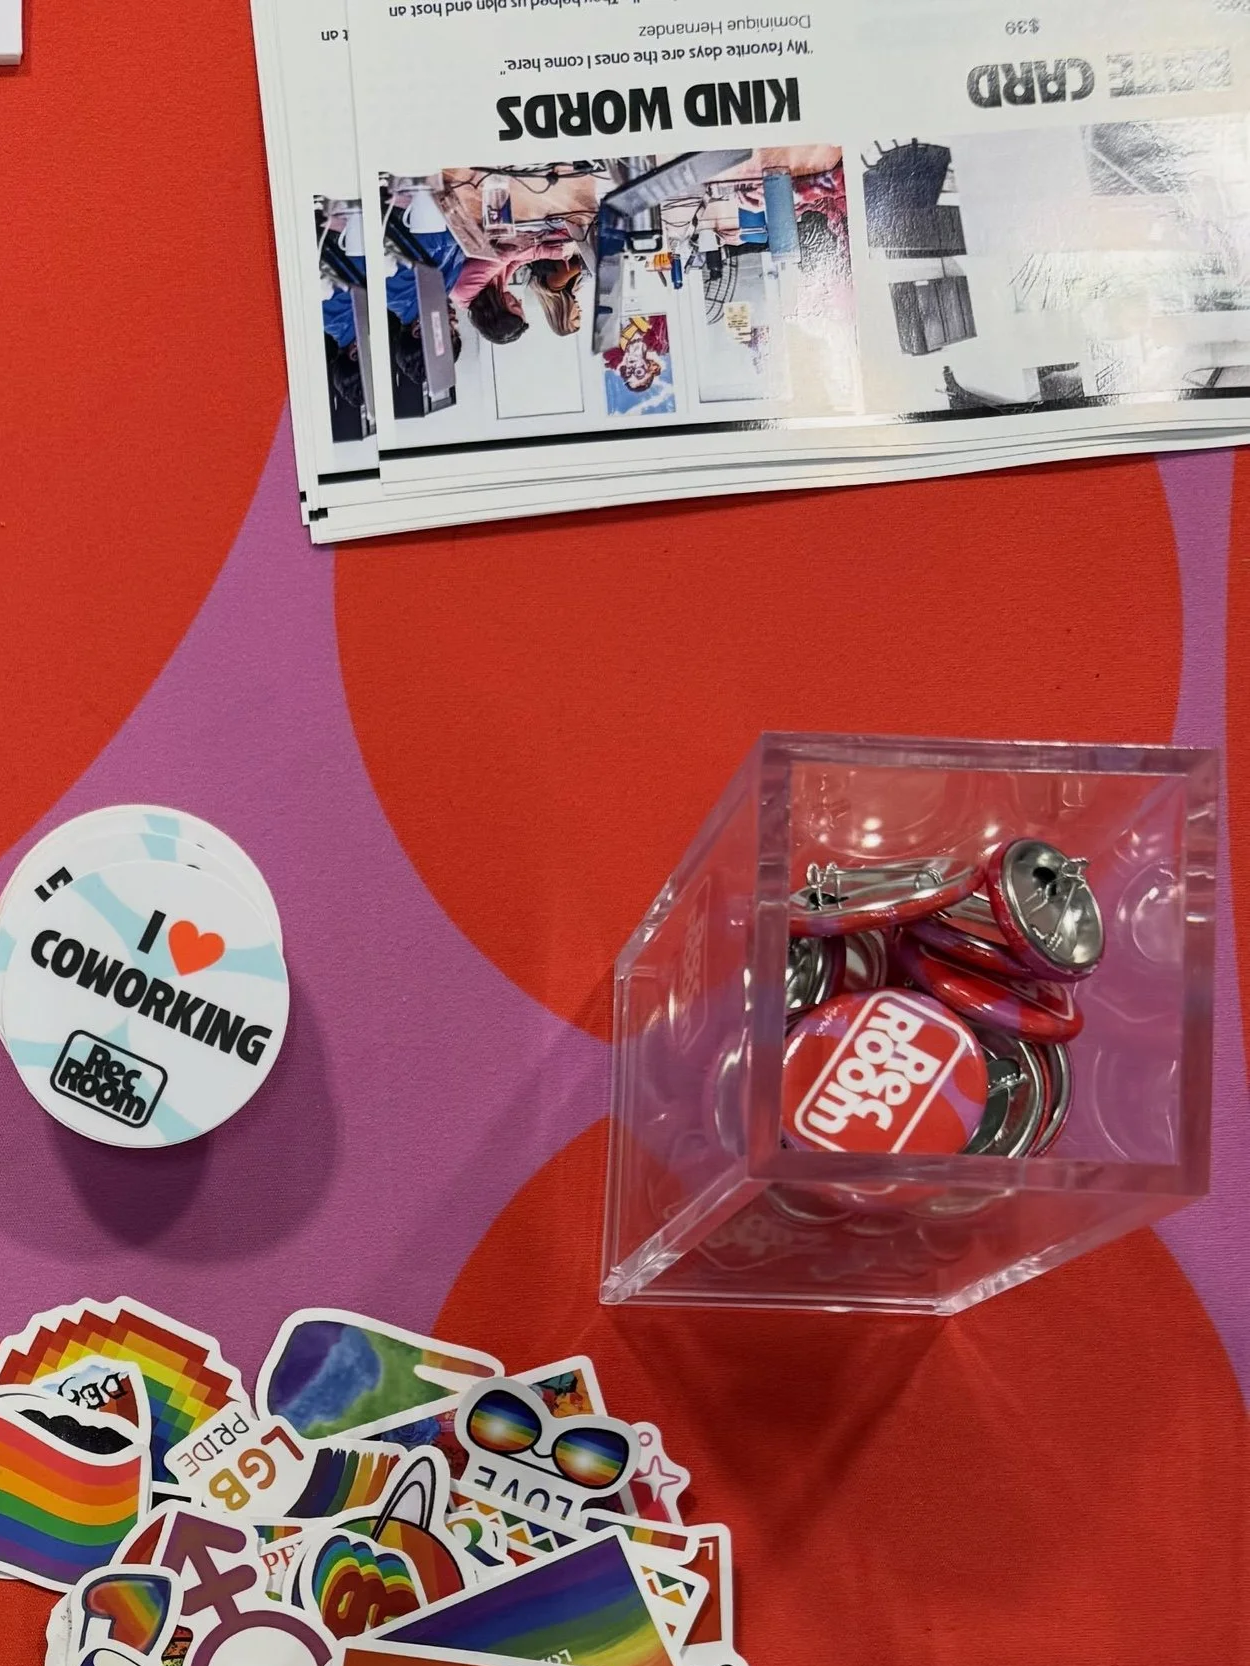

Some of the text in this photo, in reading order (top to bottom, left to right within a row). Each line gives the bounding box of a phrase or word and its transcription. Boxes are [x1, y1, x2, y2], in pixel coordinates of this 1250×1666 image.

[389, 5, 406, 17] an
[412, 2, 443, 18] host
[446, 1, 473, 17] and
[477, 0, 507, 14] plan
[638, 14, 811, 39] Dominique Hernandez
[321, 30, 339, 41] an
[633, 50, 658, 65] the
[662, 48, 685, 60] are
[689, 44, 723, 60] days
[725, 41, 784, 58] favorite
[544, 55, 584, 68] come
[594, 53, 630, 65] ones
[966, 58, 1095, 108] CARD
[496, 77, 801, 141] KIND WORDS
[137, 909, 166, 954] I
[30, 929, 273, 1066] COWORKING
[83, 1043, 142, 1094] Rec
[58, 1056, 147, 1121] Room
[177, 1412, 250, 1477] PRIDE
[206, 1425, 304, 1511] LGB
[473, 1464, 574, 1522] LOVE
